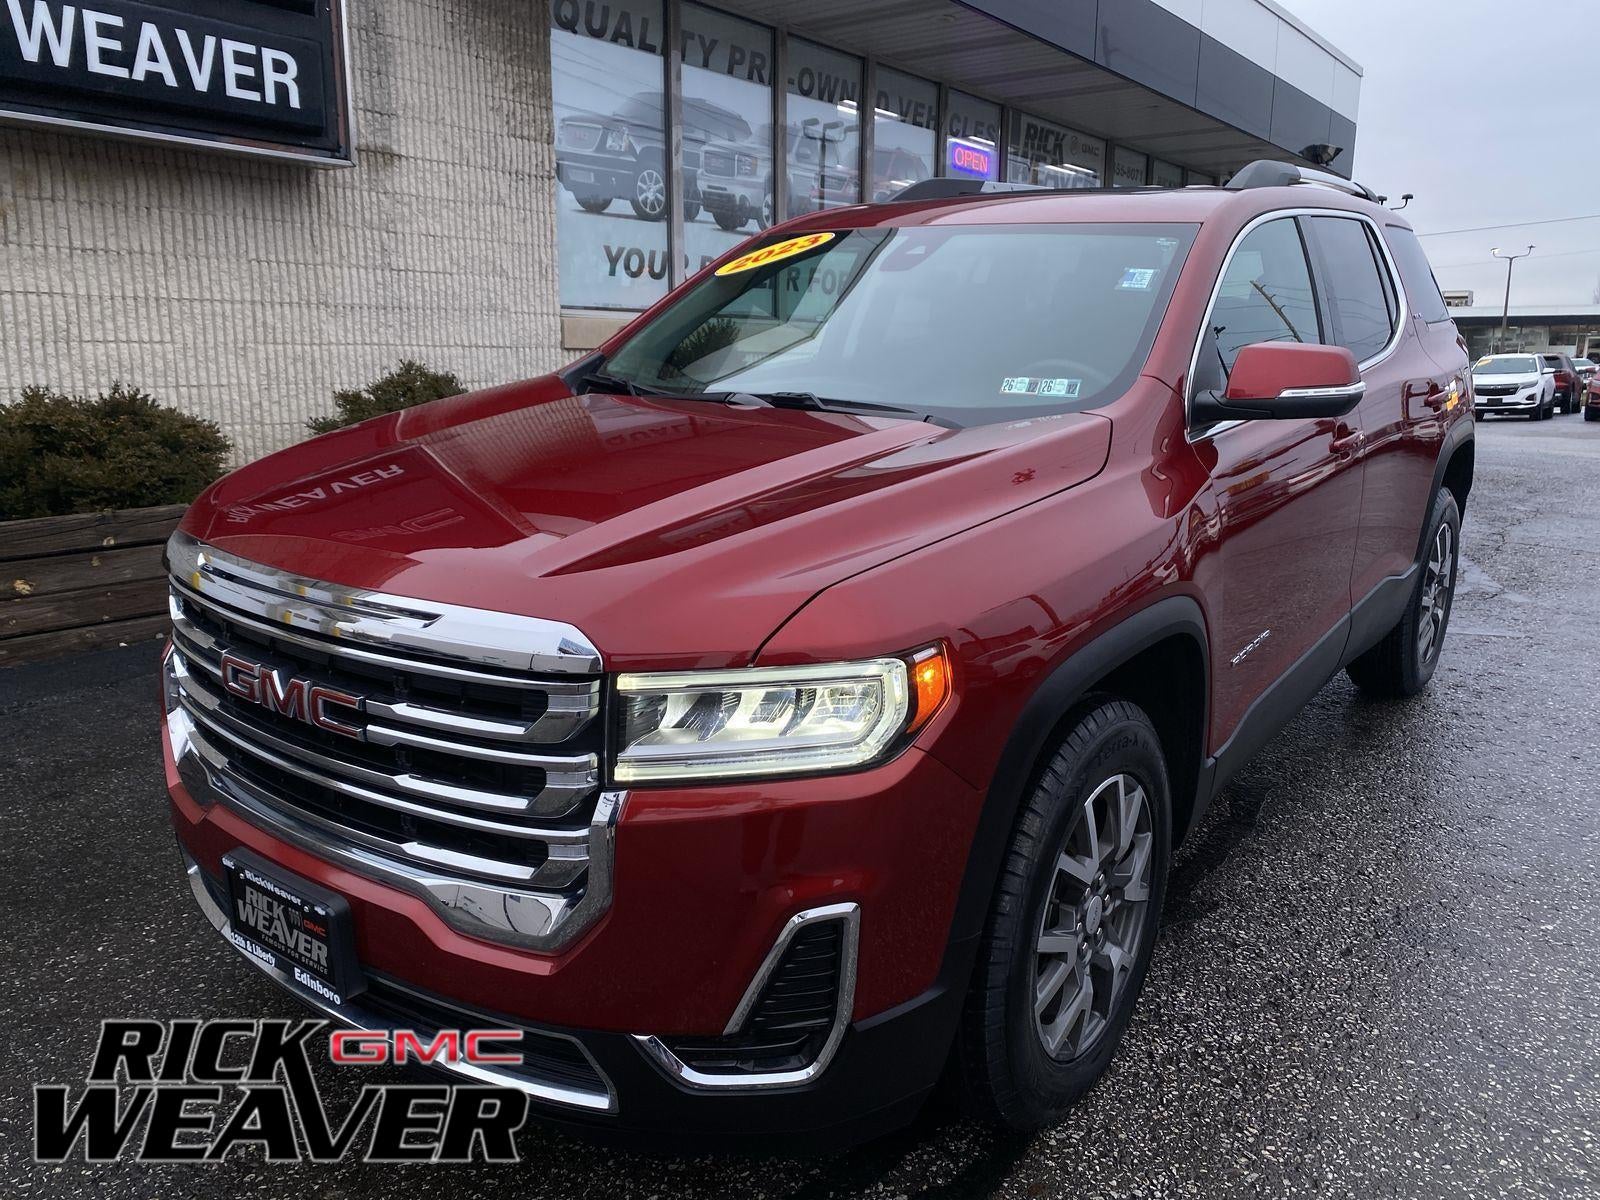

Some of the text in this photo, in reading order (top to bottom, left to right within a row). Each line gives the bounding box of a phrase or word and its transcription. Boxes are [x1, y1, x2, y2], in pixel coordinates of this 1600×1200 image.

[6, 0, 301, 109] WEAVER
[553, 0, 719, 68] QUALTY
[899, 95, 997, 143] VEHCLES
[954, 147, 988, 173] OPEN
[603, 245, 690, 281] YOU
[726, 235, 823, 272] 2023
[1003, 379, 1015, 392] 26
[1041, 381, 1077, 395] 26 12
[222, 653, 365, 741] GMC
[245, 886, 285, 920] RICK
[237, 899, 329, 967] WEAVER
[303, 919, 327, 937] GMC
[252, 943, 276, 967] Liberty
[294, 966, 341, 1005] Edinboro
